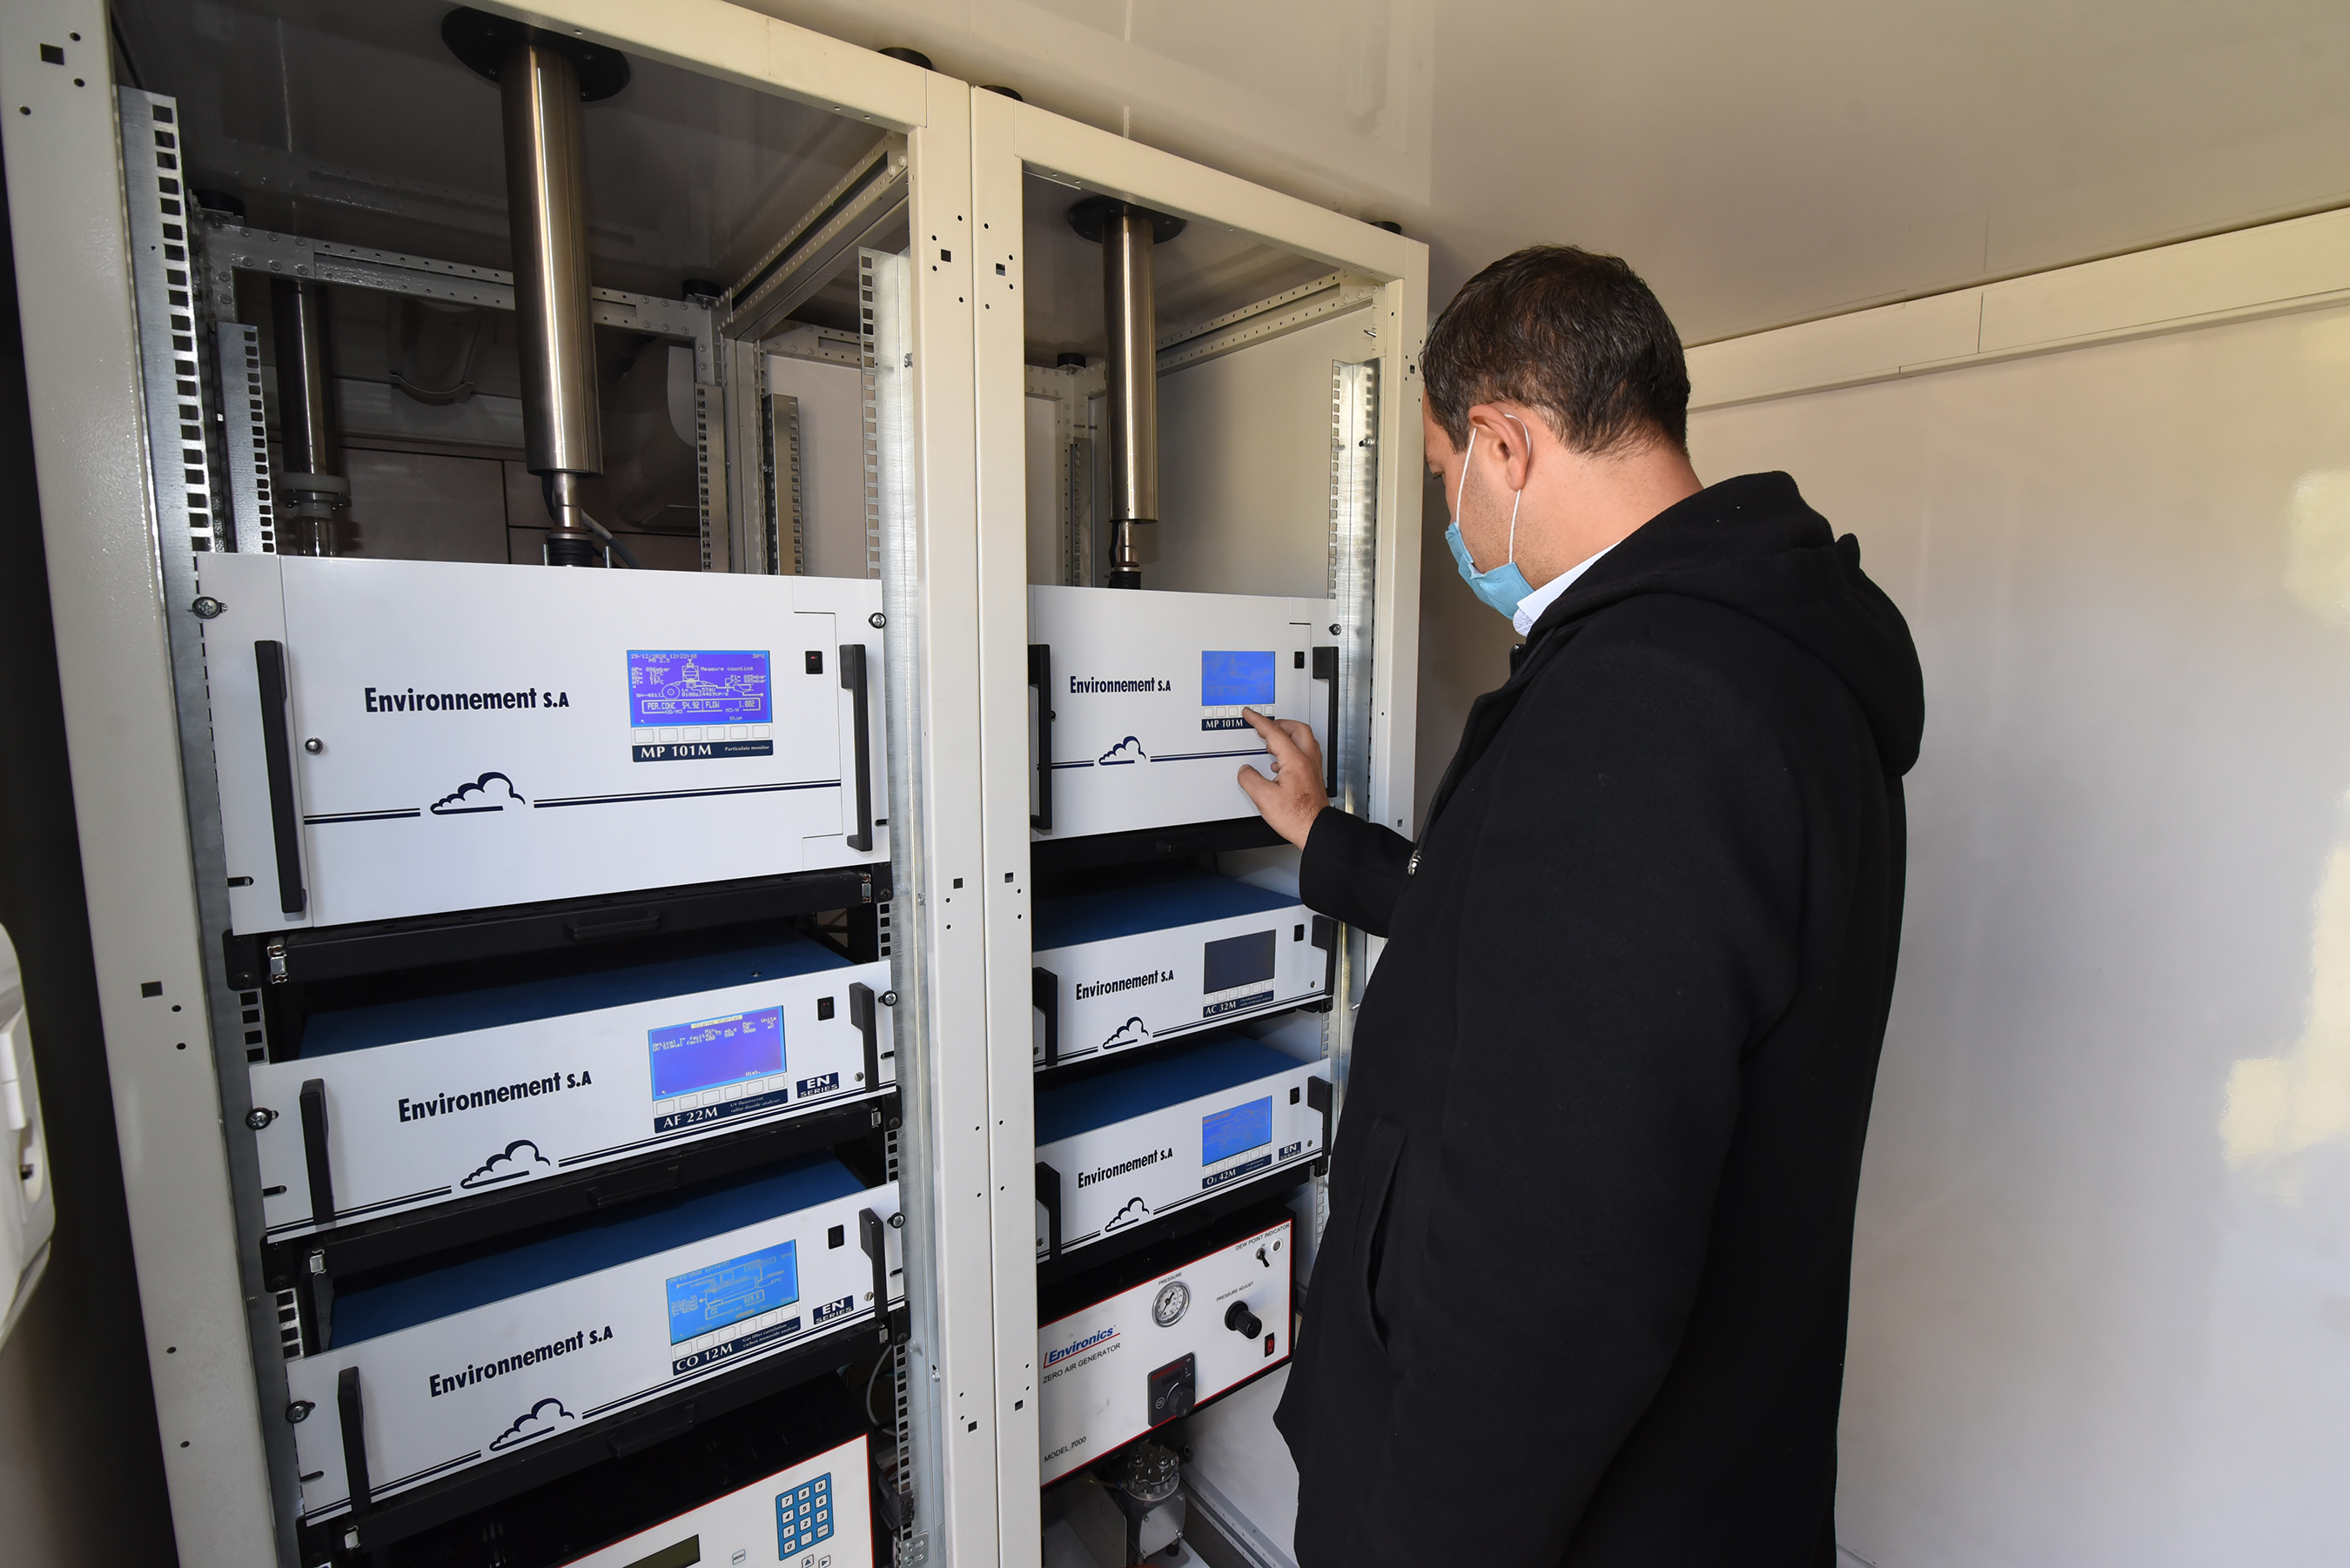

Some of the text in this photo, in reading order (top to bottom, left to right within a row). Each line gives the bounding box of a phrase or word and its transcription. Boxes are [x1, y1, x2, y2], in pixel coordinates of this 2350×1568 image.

[1070, 675, 1155, 694] Environnement
[365, 687, 537, 713] Environnement
[1205, 719, 1243, 728] MP 101M
[641, 744, 712, 759] MP 101M
[1076, 969, 1158, 1001] Environnement
[1205, 1004, 1217, 1015] AC
[1219, 1001, 1236, 1012] 32M
[800, 1084, 837, 1098] SERIES
[806, 1075, 830, 1089] EN
[399, 1072, 561, 1122] Environnement
[663, 1107, 718, 1129] AF 22M
[1284, 1143, 1297, 1154] EN
[1078, 1149, 1158, 1189] Environnement
[1219, 1169, 1236, 1181] 42M
[1236, 1223, 1290, 1250] DEW POINT INDICATOR
[1158, 1271, 1182, 1286] PRESSURE
[1216, 1280, 1253, 1302] PRESSURE ADJUST
[816, 1307, 852, 1324] SERIES
[822, 1299, 845, 1314] EN
[1048, 1327, 1113, 1364] Environics
[429, 1330, 584, 1397] Environnement
[676, 1343, 733, 1371] CO 12M
[1043, 1343, 1121, 1384] ZERO AIR GENERATOR
[1044, 1436, 1087, 1463] MODEL 7000
